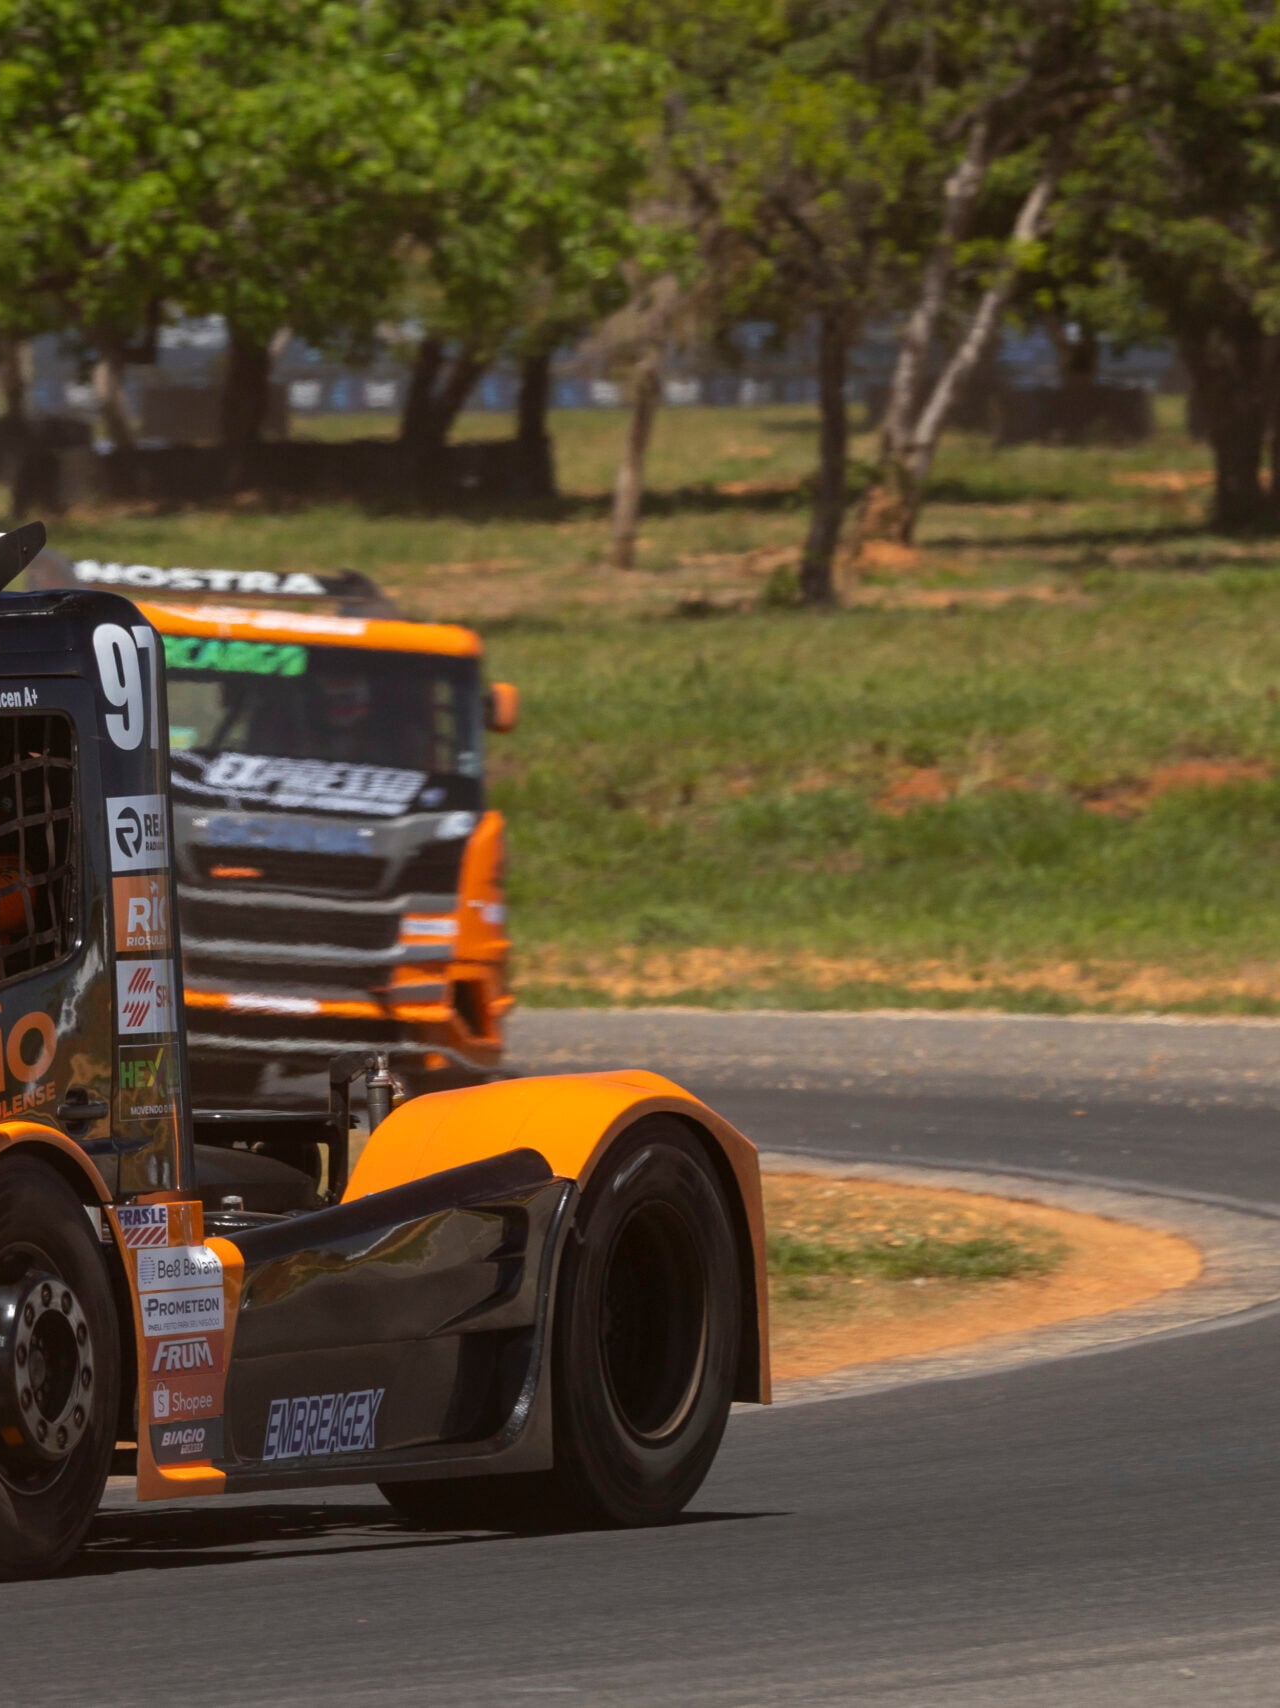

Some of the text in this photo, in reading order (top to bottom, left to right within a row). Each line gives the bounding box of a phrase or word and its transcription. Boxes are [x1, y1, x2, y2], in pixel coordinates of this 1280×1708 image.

[24, 686, 38, 707] A+
[157, 1257, 221, 1279] Be8 BeVant
[145, 1297, 220, 1318] PROMETEON
[152, 1336, 215, 1373] FRUM
[172, 1392, 213, 1416] Shopee
[262, 1388, 385, 1461] EMBREAGEX
[161, 1427, 206, 1447] BIAGIO
